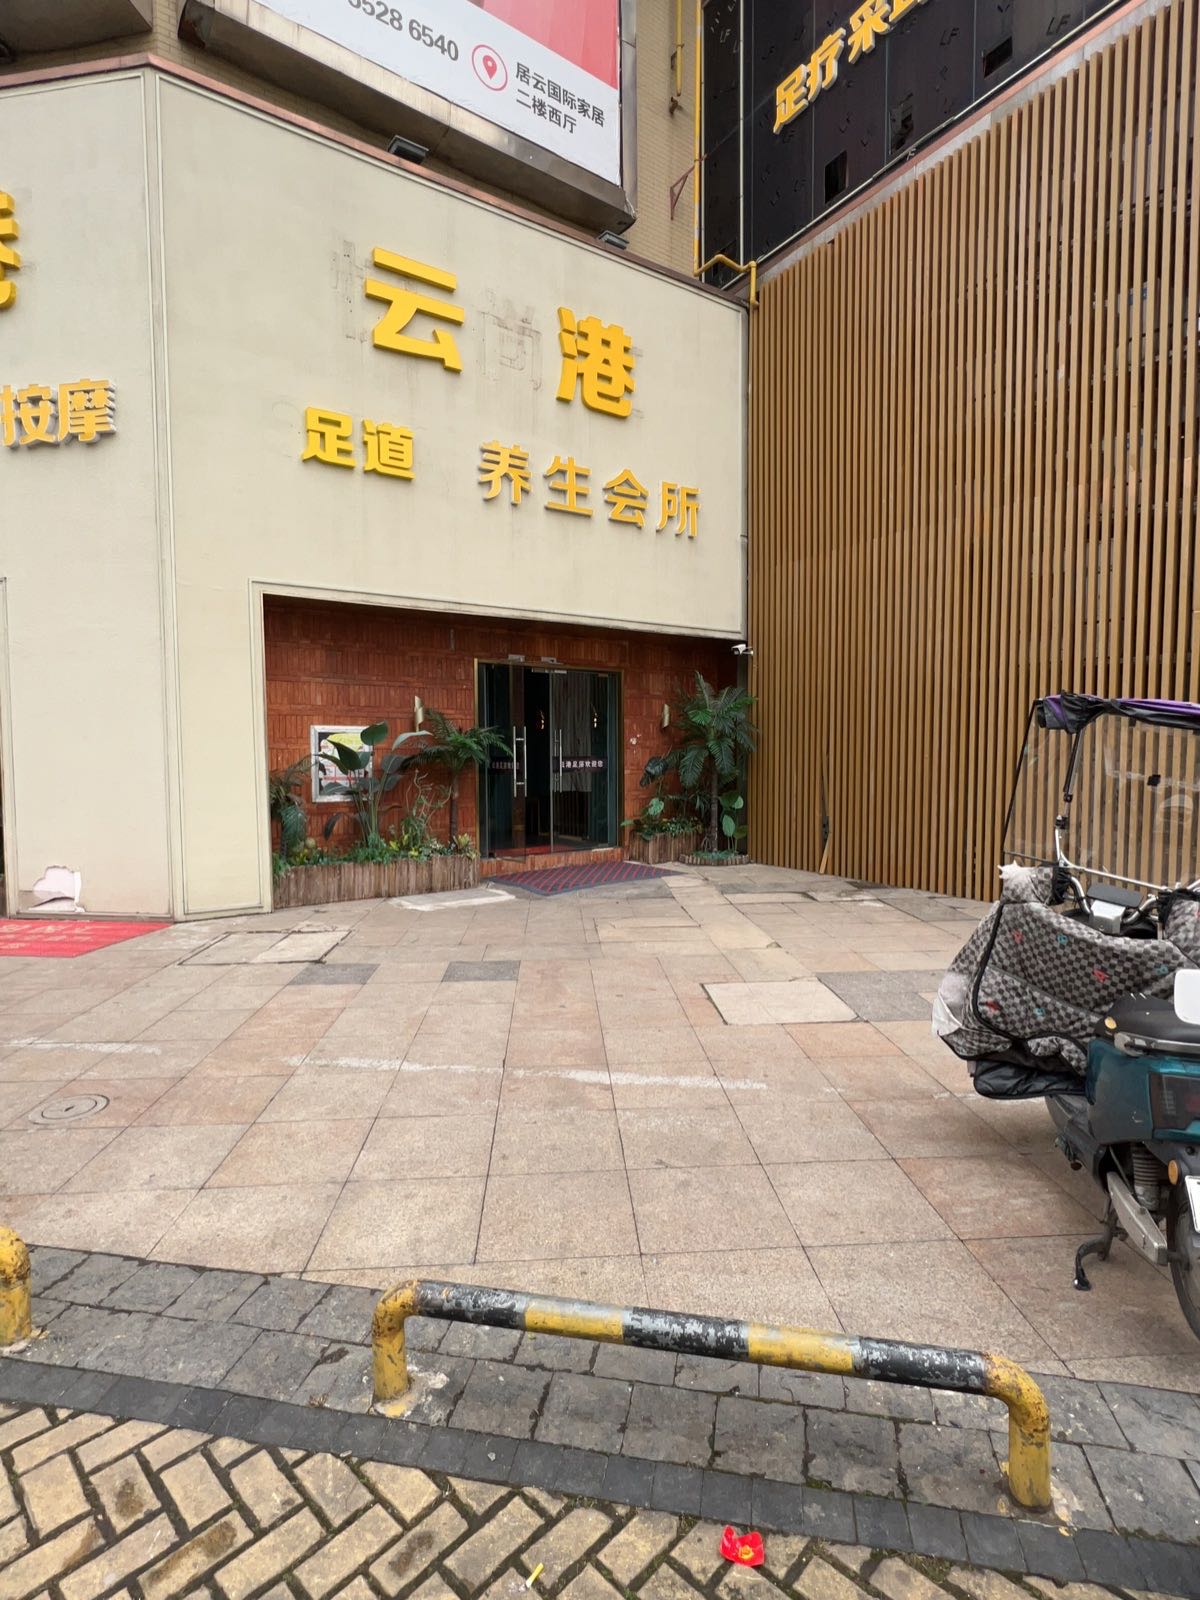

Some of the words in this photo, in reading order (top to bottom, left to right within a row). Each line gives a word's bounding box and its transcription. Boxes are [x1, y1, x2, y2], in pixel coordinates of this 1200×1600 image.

[408, 19, 459, 61] 6540
[516, 62, 605, 128] 居云国际家居
[516, 89, 577, 134] 二楼西厅
[0, 379, 117, 449] 按摩
[302, 407, 415, 481] 足道
[478, 440, 701, 539] 养生会所
